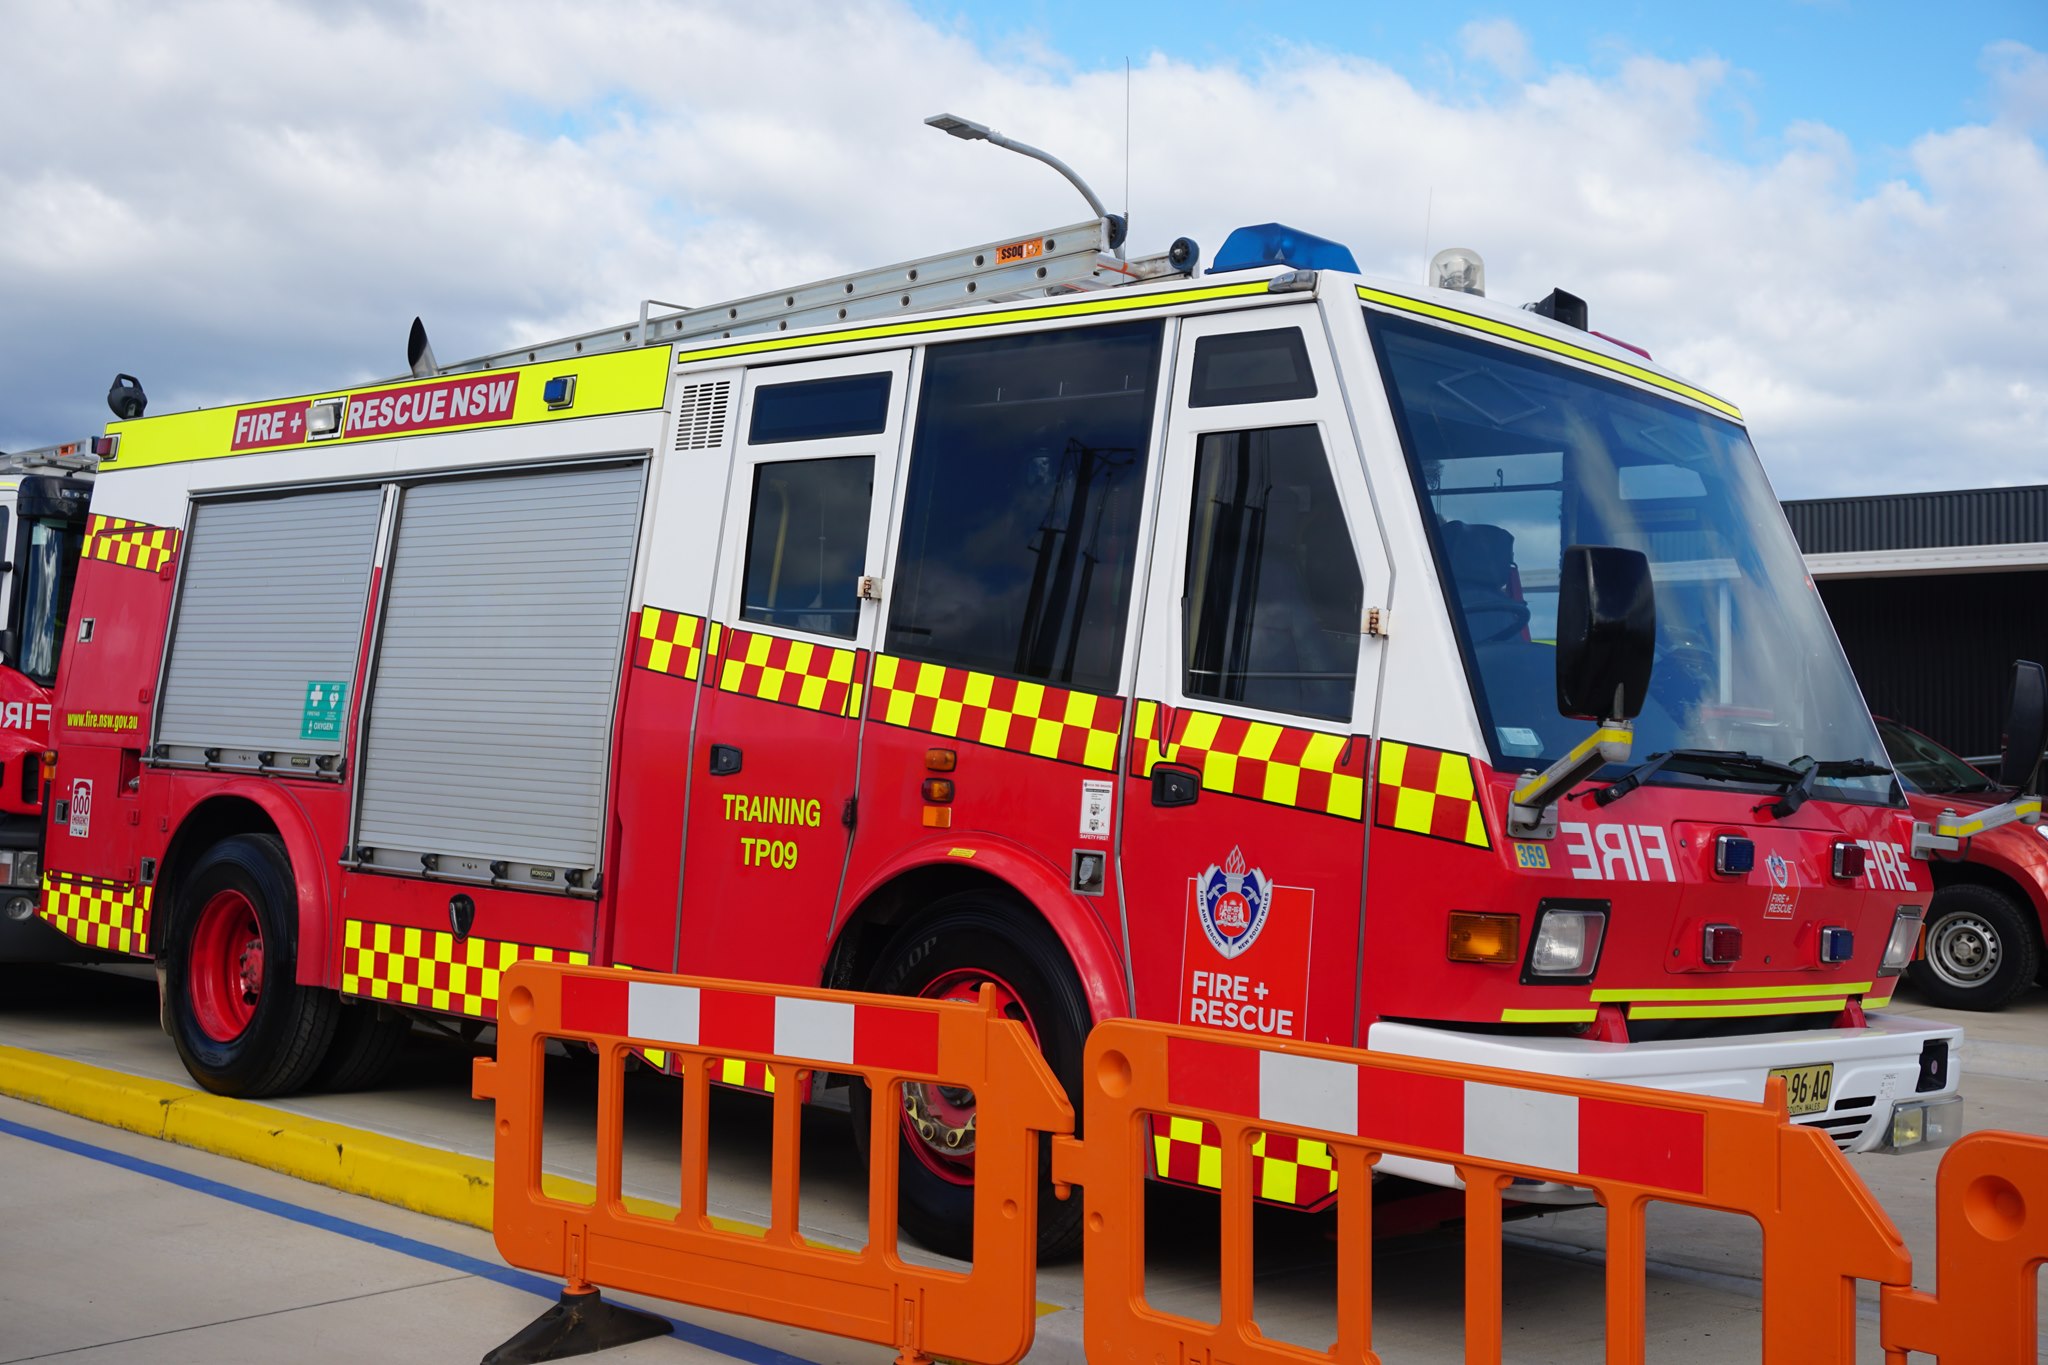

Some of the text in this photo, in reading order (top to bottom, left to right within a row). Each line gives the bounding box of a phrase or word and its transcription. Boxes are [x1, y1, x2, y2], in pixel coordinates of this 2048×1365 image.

[235, 411, 286, 444] FIRE
[346, 389, 448, 432] RESCUE
[450, 380, 515, 419] NSW
[67, 710, 138, 732] www.fire.nsw.gov.au
[314, 722, 334, 731] OXYGEN
[73, 795, 90, 815] 000
[722, 794, 821, 828] TRAINING
[741, 837, 798, 870] TP09
[1517, 844, 1546, 868] 369
[1855, 839, 1918, 892] FIRE
[1238, 892, 1269, 951] NEW SOUTH WALES
[1769, 903, 1793, 913] RESCUE
[1206, 924, 1223, 949] RESCUE
[1190, 997, 1294, 1036] RESCUE
